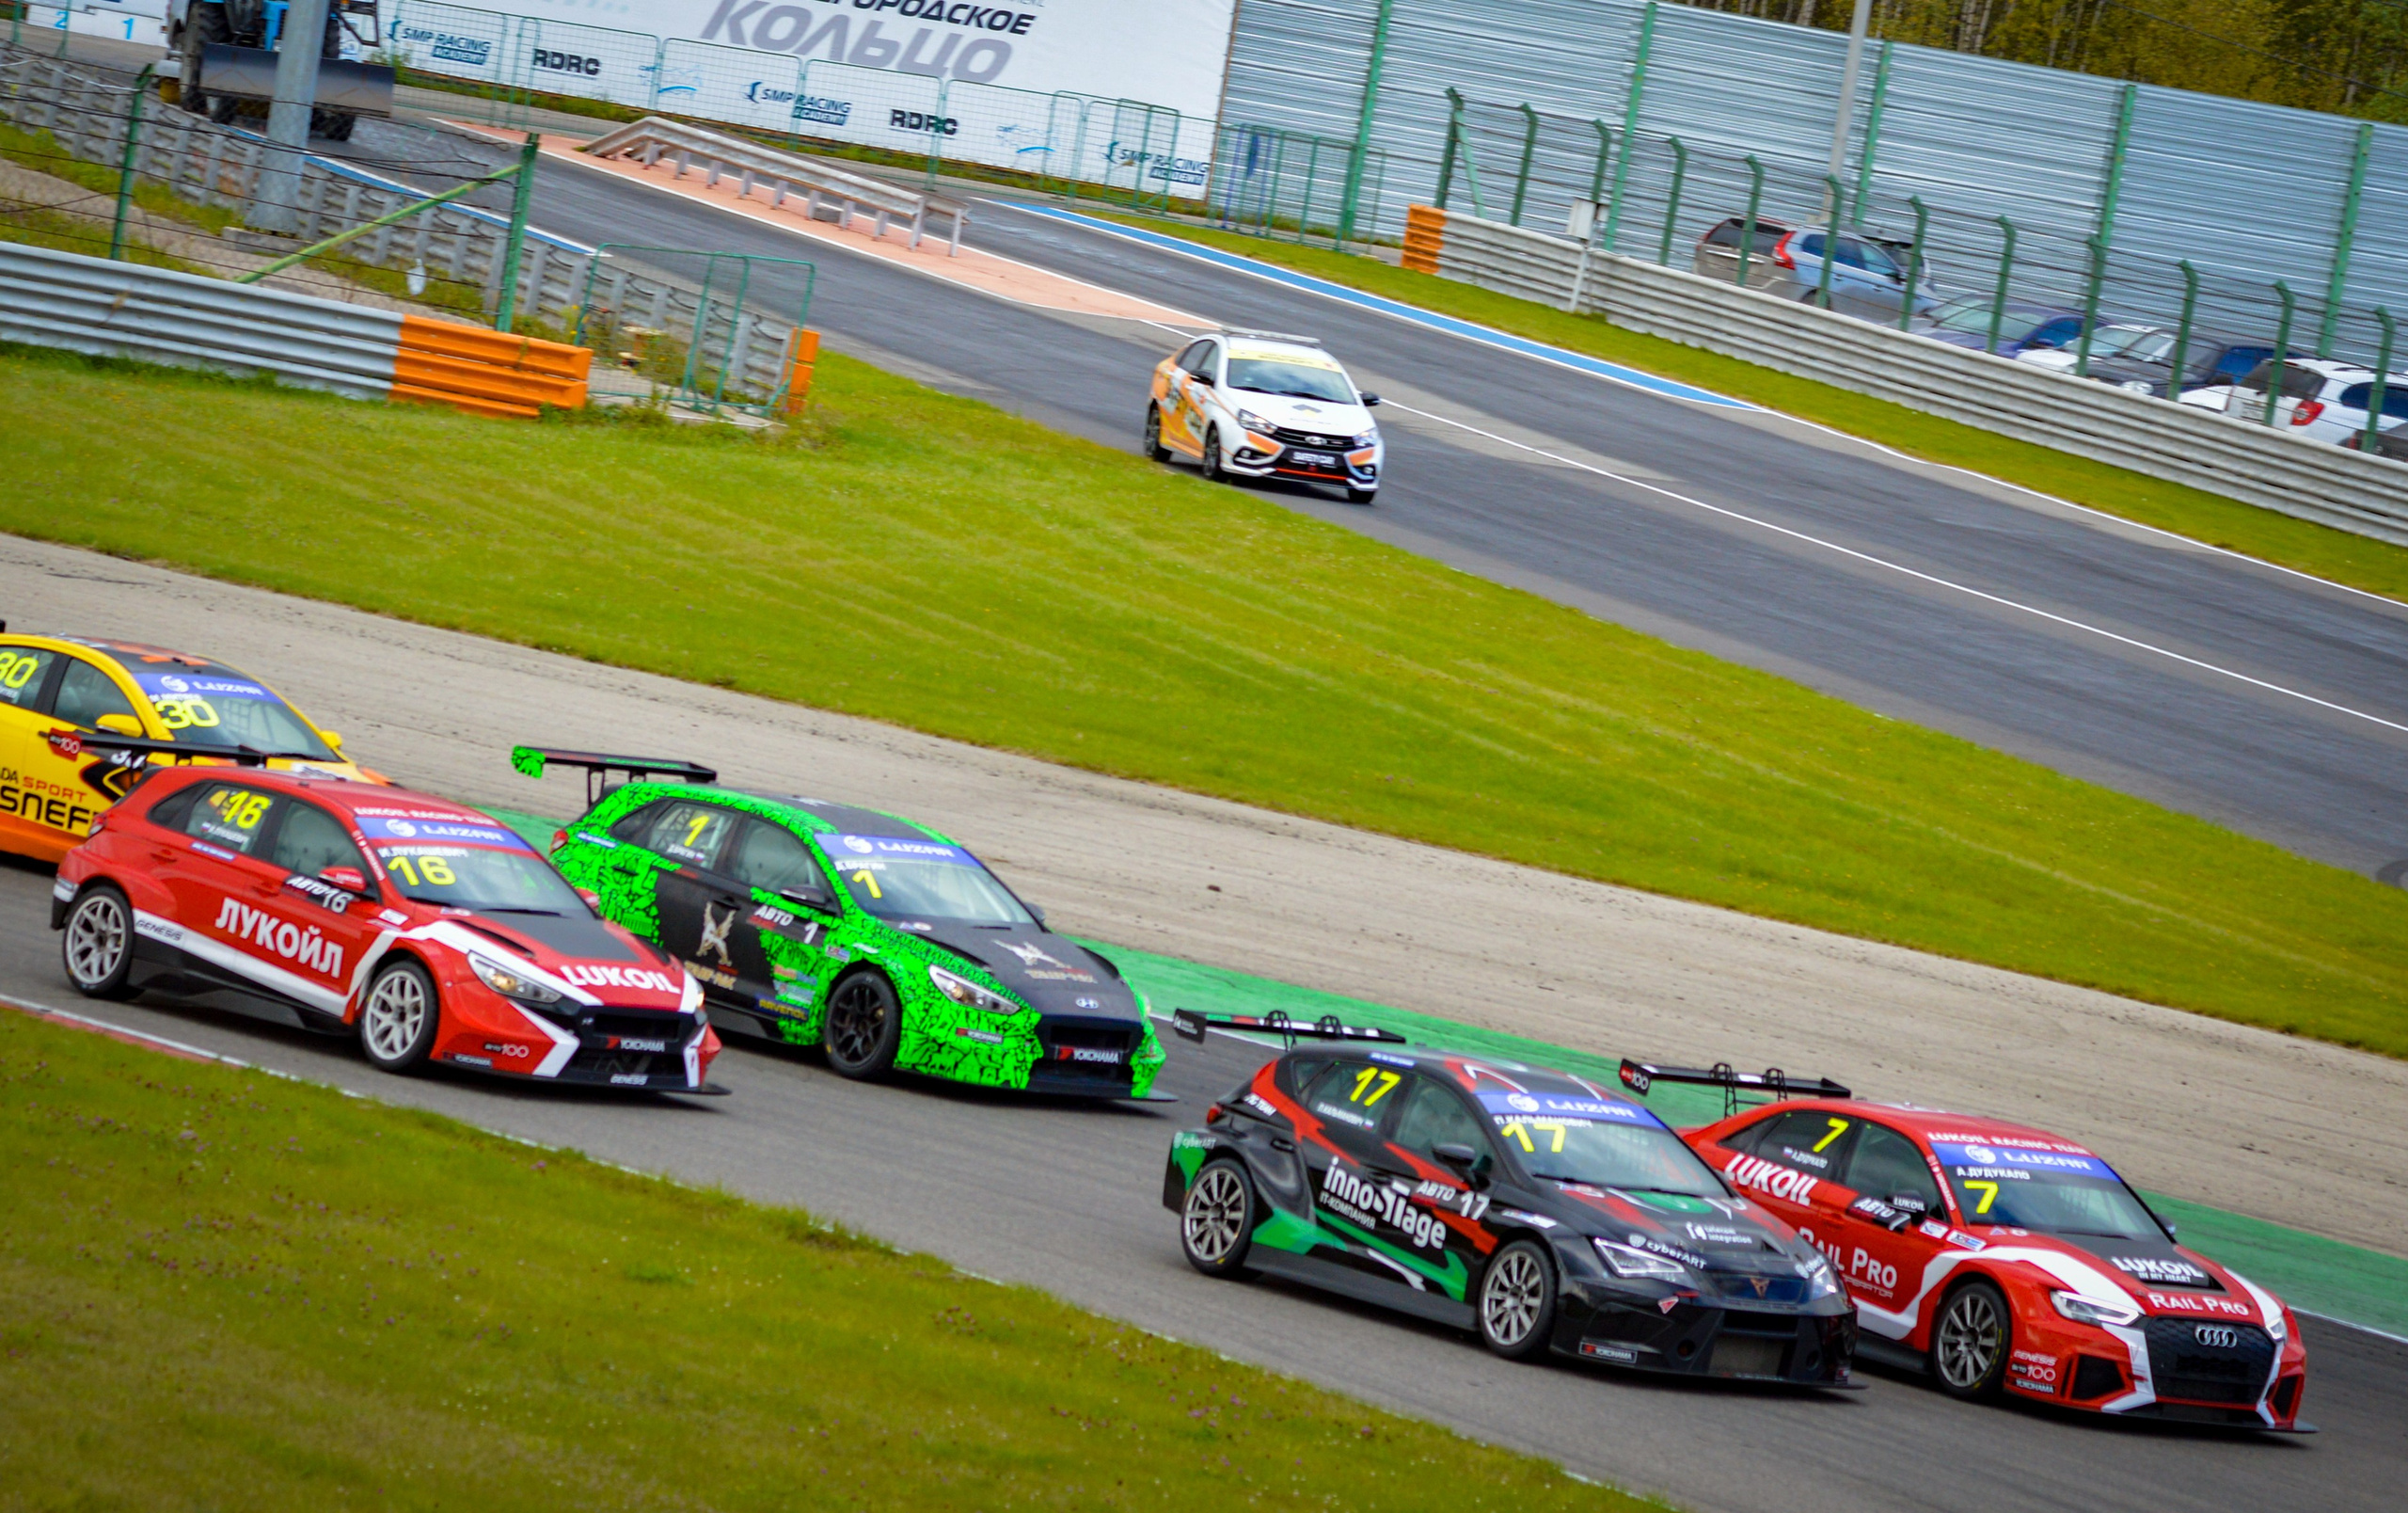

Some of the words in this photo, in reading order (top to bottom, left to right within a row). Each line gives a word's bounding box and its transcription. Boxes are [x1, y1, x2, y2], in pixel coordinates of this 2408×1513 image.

[55, 11, 69, 30] 2
[121, 17, 135, 40] 1
[435, 32, 491, 53] RACING
[699, 0, 1013, 83] КОЛЬЦО
[532, 48, 599, 75] RDRC
[761, 88, 794, 104] SMP
[890, 108, 958, 135] RDRC
[0, 651, 40, 689] 30
[154, 699, 221, 729] 30
[22, 775, 88, 804] SPORT
[0, 785, 101, 831] SNEF
[223, 791, 271, 829] 16
[684, 815, 710, 847] 1
[387, 855, 456, 886] 16
[851, 868, 882, 899] 1
[322, 888, 356, 914] 16
[135, 918, 183, 942] GENESIS
[214, 896, 344, 979] ЛУКОЙЛ
[754, 904, 795, 927] АВТО
[803, 922, 820, 945] 1
[559, 965, 682, 995] LUKOIL
[501, 1043, 530, 1059] 100
[619, 1038, 666, 1053] YOKOHAMA
[1073, 1049, 1119, 1064] YOKOHAMA
[610, 1074, 650, 1086] GENESIS
[1350, 1067, 1402, 1107] 17
[1545, 1099, 1638, 1119] LUZAR
[1501, 1122, 1566, 1153] 17
[1812, 1117, 1849, 1154] 7
[1927, 1132, 1990, 1144] LUKOIL
[1990, 1136, 2052, 1151] RACING
[1956, 1166, 2031, 1180] А.ДУДУКАЛО
[2003, 1151, 2093, 1171] LUZAR
[1724, 1151, 1818, 1207] LUKOIL
[1319, 1190, 1377, 1230] IT-КОМПАНИЯ
[1416, 1179, 1456, 1202] АВТО
[1460, 1190, 1491, 1221] 17
[1893, 1194, 1925, 1212] LUKOIL
[1964, 1180, 2000, 1214] 7
[1888, 1211, 1912, 1232] 7
[1646, 1240, 1708, 1270] cyberART
[1850, 1246, 1898, 1290] PRO
[2110, 1256, 2205, 1279] LUKOIL
[1843, 1273, 1894, 1299] PERATOR
[2138, 1271, 2149, 1280] IN
[2150, 1272, 2164, 1281] MY
[2164, 1273, 2192, 1283] HEART
[2147, 1292, 2204, 1312] RAIL
[2202, 1296, 2250, 1316] PRO
[2013, 1348, 2058, 1367] GENESIS
[2016, 1378, 2054, 1394] YOKOHAMA
[2027, 1364, 2056, 1382] 100
